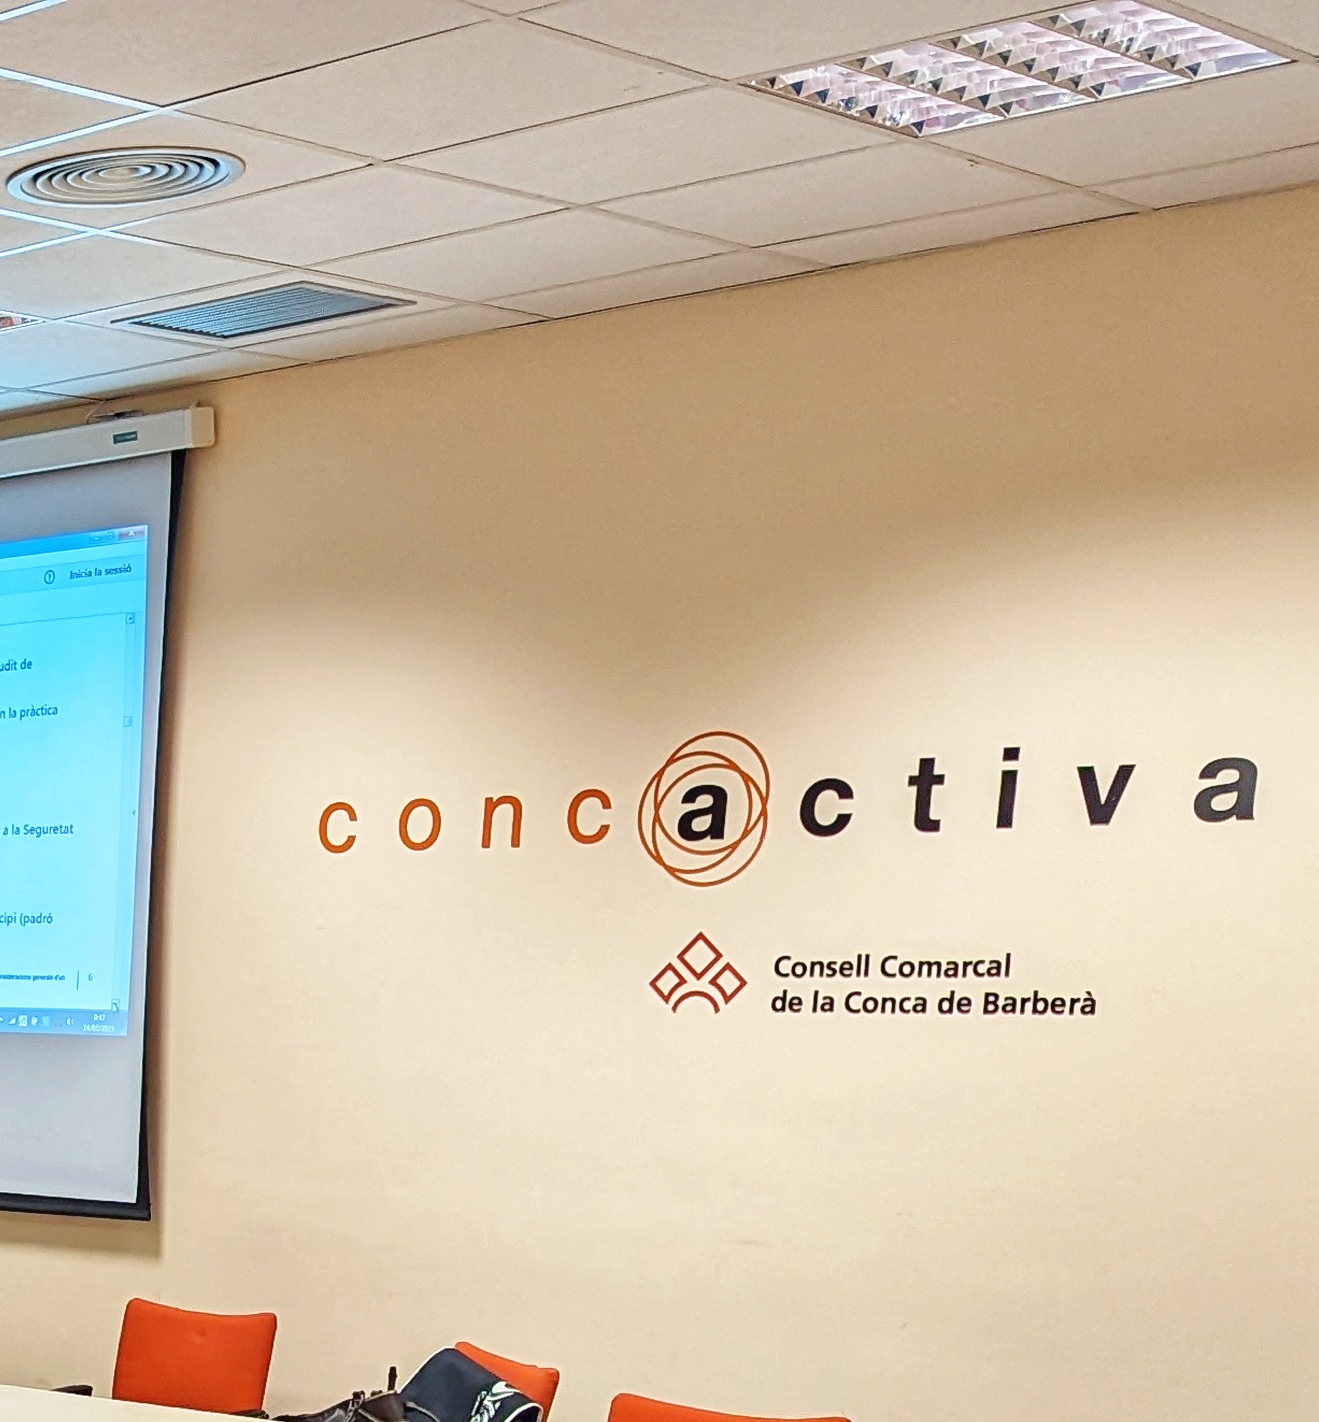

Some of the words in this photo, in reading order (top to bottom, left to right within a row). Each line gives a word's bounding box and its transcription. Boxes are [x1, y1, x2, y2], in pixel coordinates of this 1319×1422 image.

[774, 953, 870, 978] Consell
[880, 952, 1011, 978] Comarcal
[771, 989, 803, 1013] de
[811, 989, 834, 1013] la
[844, 990, 927, 1014] Conca
[937, 989, 972, 1014] de
[982, 989, 1096, 1015] Barberà
